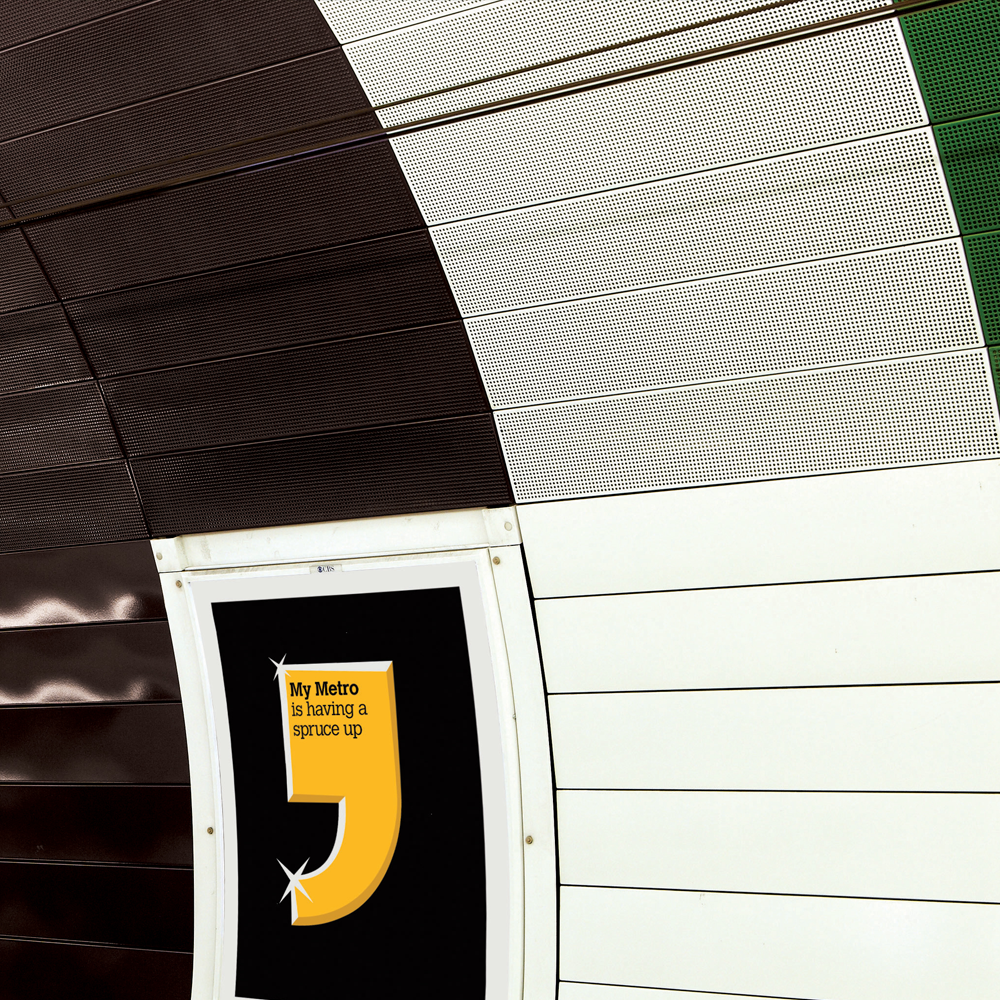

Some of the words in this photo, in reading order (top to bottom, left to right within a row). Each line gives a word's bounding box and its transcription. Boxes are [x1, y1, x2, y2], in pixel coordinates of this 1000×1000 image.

[290, 682, 311, 700] My
[315, 681, 359, 696] Metro
[291, 702, 303, 716] is
[306, 701, 354, 719] having
[358, 703, 368, 716] a
[293, 724, 340, 740] spruce
[343, 724, 363, 739] up
